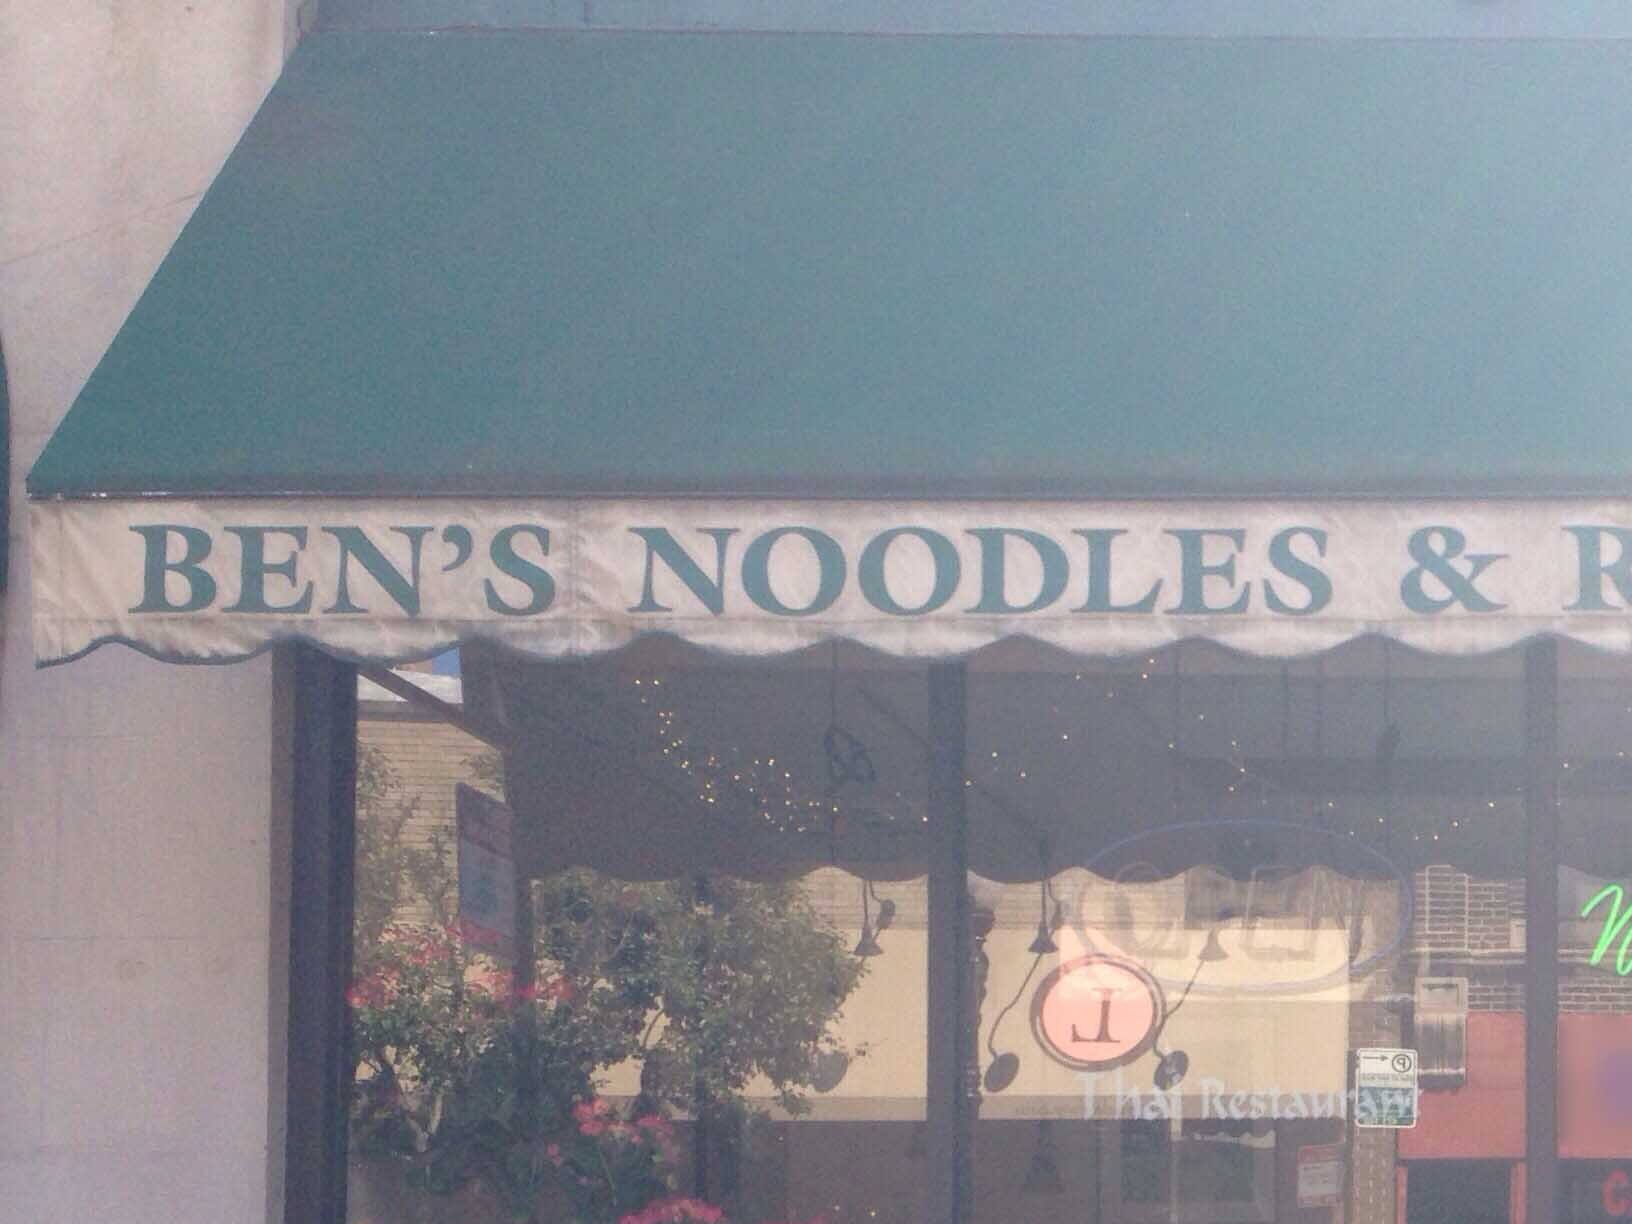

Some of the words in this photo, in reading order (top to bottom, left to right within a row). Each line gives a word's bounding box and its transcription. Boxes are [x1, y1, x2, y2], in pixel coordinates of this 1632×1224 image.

[129, 522, 557, 617] BEN'S
[627, 524, 1333, 617] NOODLES
[1401, 524, 1509, 614] &
[1074, 1071, 1184, 1122] Thai
